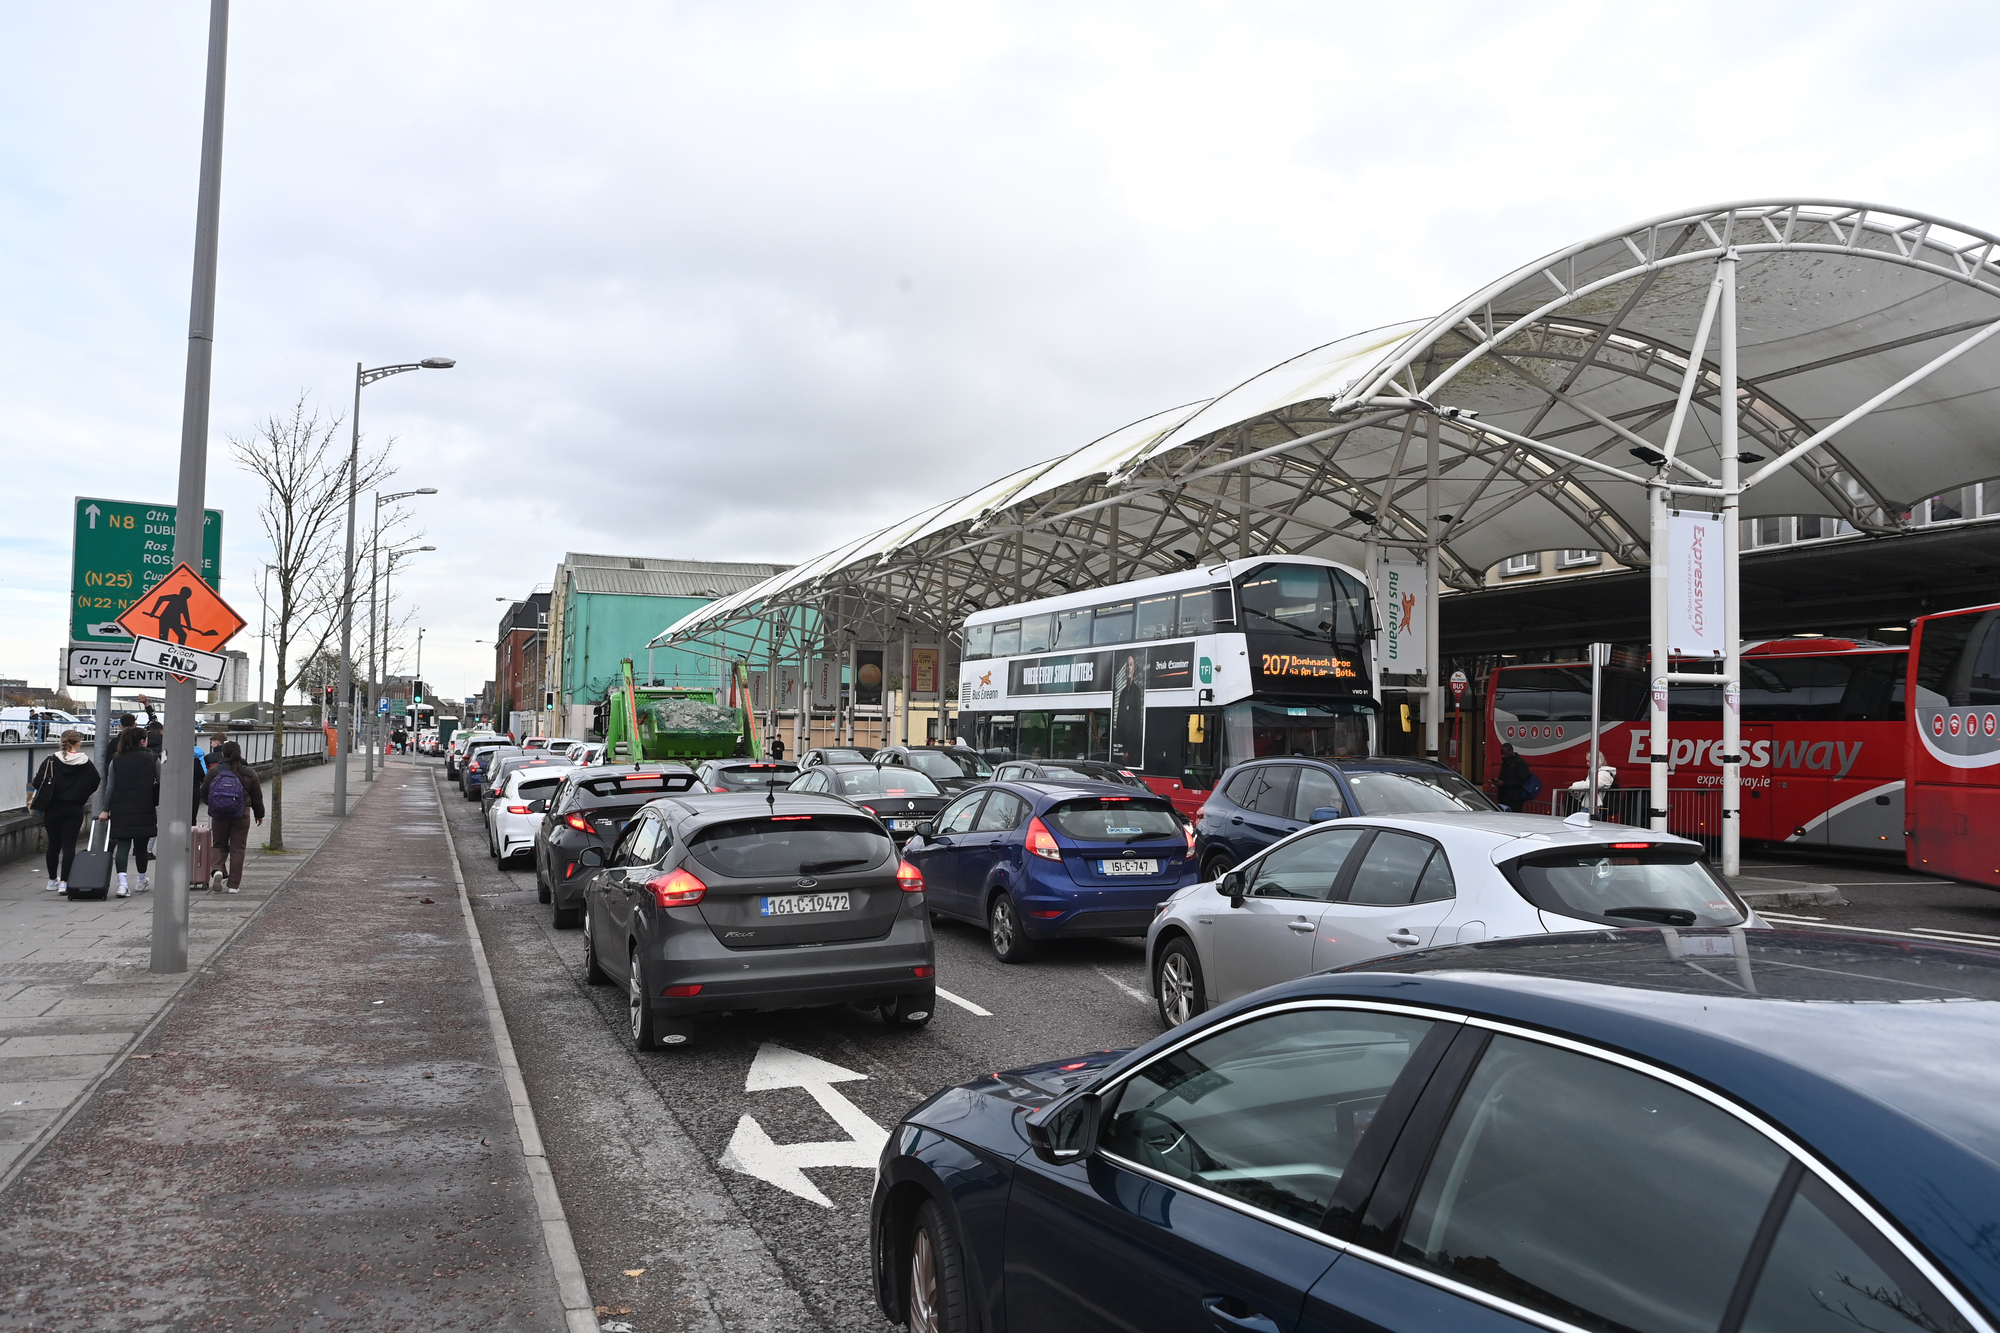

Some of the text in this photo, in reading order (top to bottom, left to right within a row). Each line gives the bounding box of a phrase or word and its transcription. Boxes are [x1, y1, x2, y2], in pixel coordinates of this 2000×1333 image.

[144, 524, 176, 536] DUBL
[144, 540, 167, 551] Ros
[143, 553, 212, 568] ROSE
[1691, 524, 1705, 638] Expressway
[1388, 570, 1401, 660] Bus Éireann
[80, 655, 126, 666] An Lár
[158, 652, 197, 672] END
[1155, 660, 1189, 670] Irish Examiner
[1262, 654, 1290, 675] 207
[1291, 655, 1352, 668] Domhnach Broc
[79, 669, 166, 681] CITY CENTR
[1023, 662, 1094, 685] WHERE EVERY STORY MATTERS
[1200, 665, 1211, 675] TFI
[1313, 667, 1328, 677] Lár
[821, 662, 830, 700] Expressway
[972, 686, 999, 700] Bus Éireann
[1654, 692, 1667, 700] BU
[1728, 695, 1740, 704] BU
[1627, 729, 1864, 782] Epressway
[1697, 775, 1771, 790] expreway.ie
[1111, 861, 1148, 871] 151-C-747
